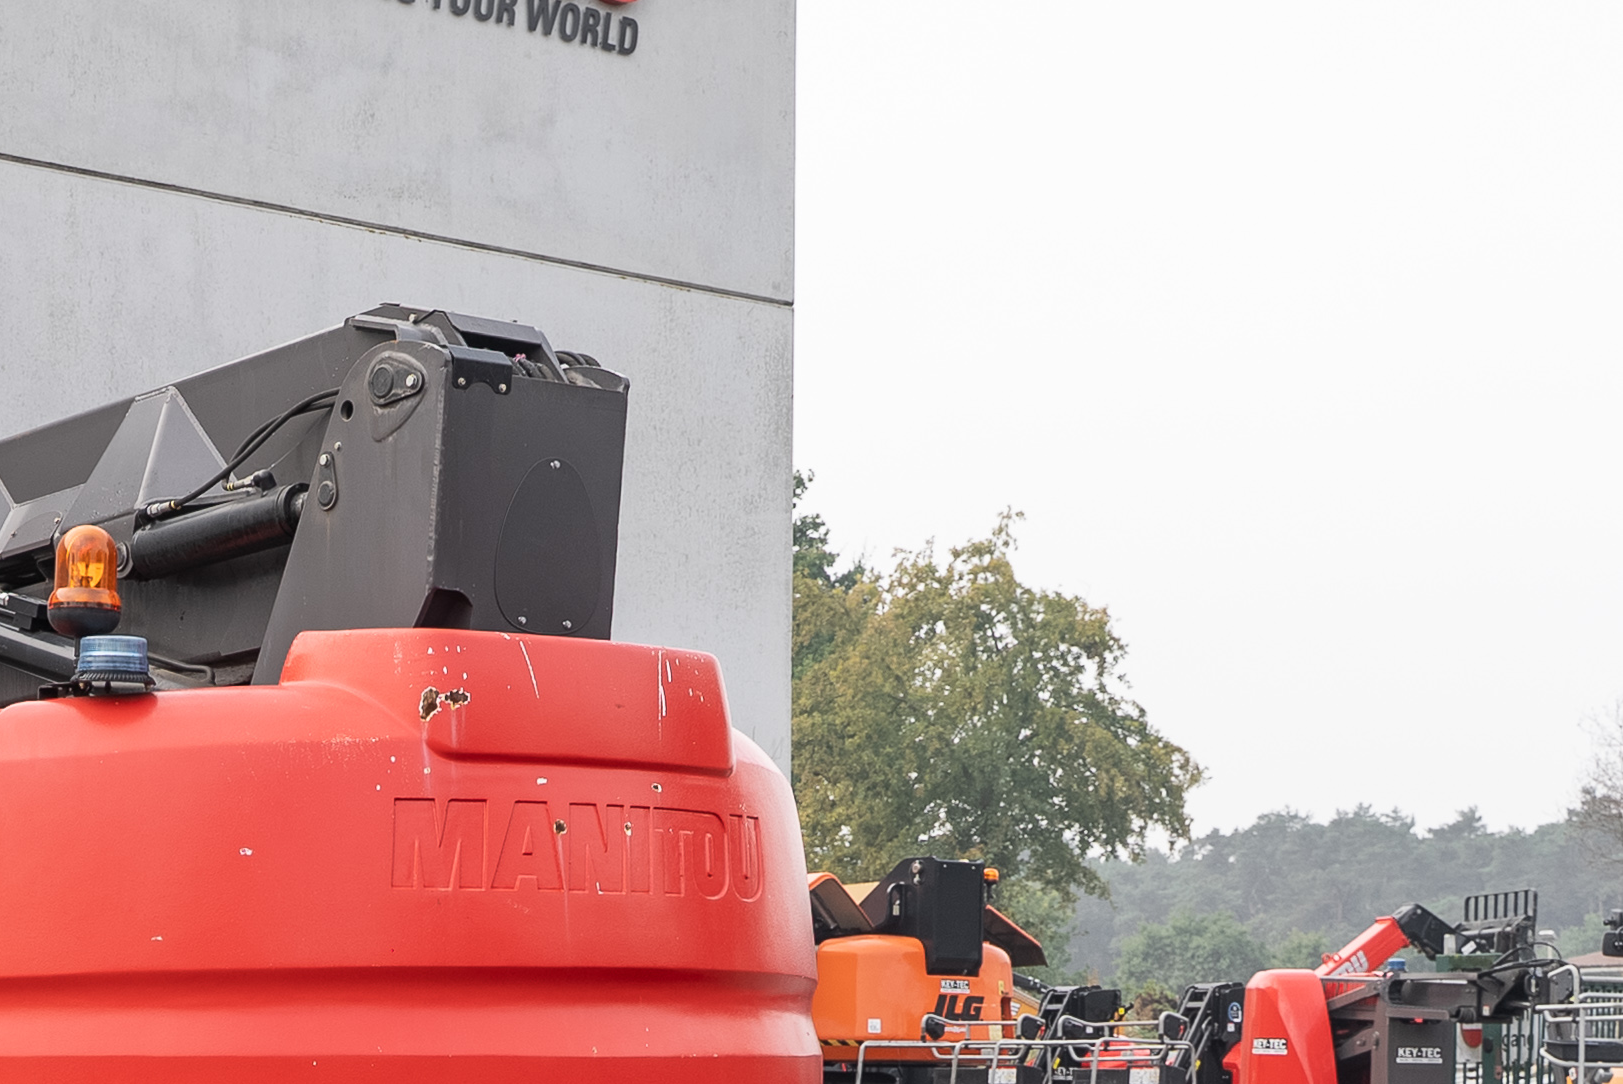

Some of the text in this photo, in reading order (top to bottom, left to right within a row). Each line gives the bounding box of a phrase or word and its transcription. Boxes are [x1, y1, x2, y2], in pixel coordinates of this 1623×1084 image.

[527, 0, 639, 55] WORLD
[391, 797, 765, 902] MANITOU
[1397, 1047, 1441, 1058] KEY-TEC
